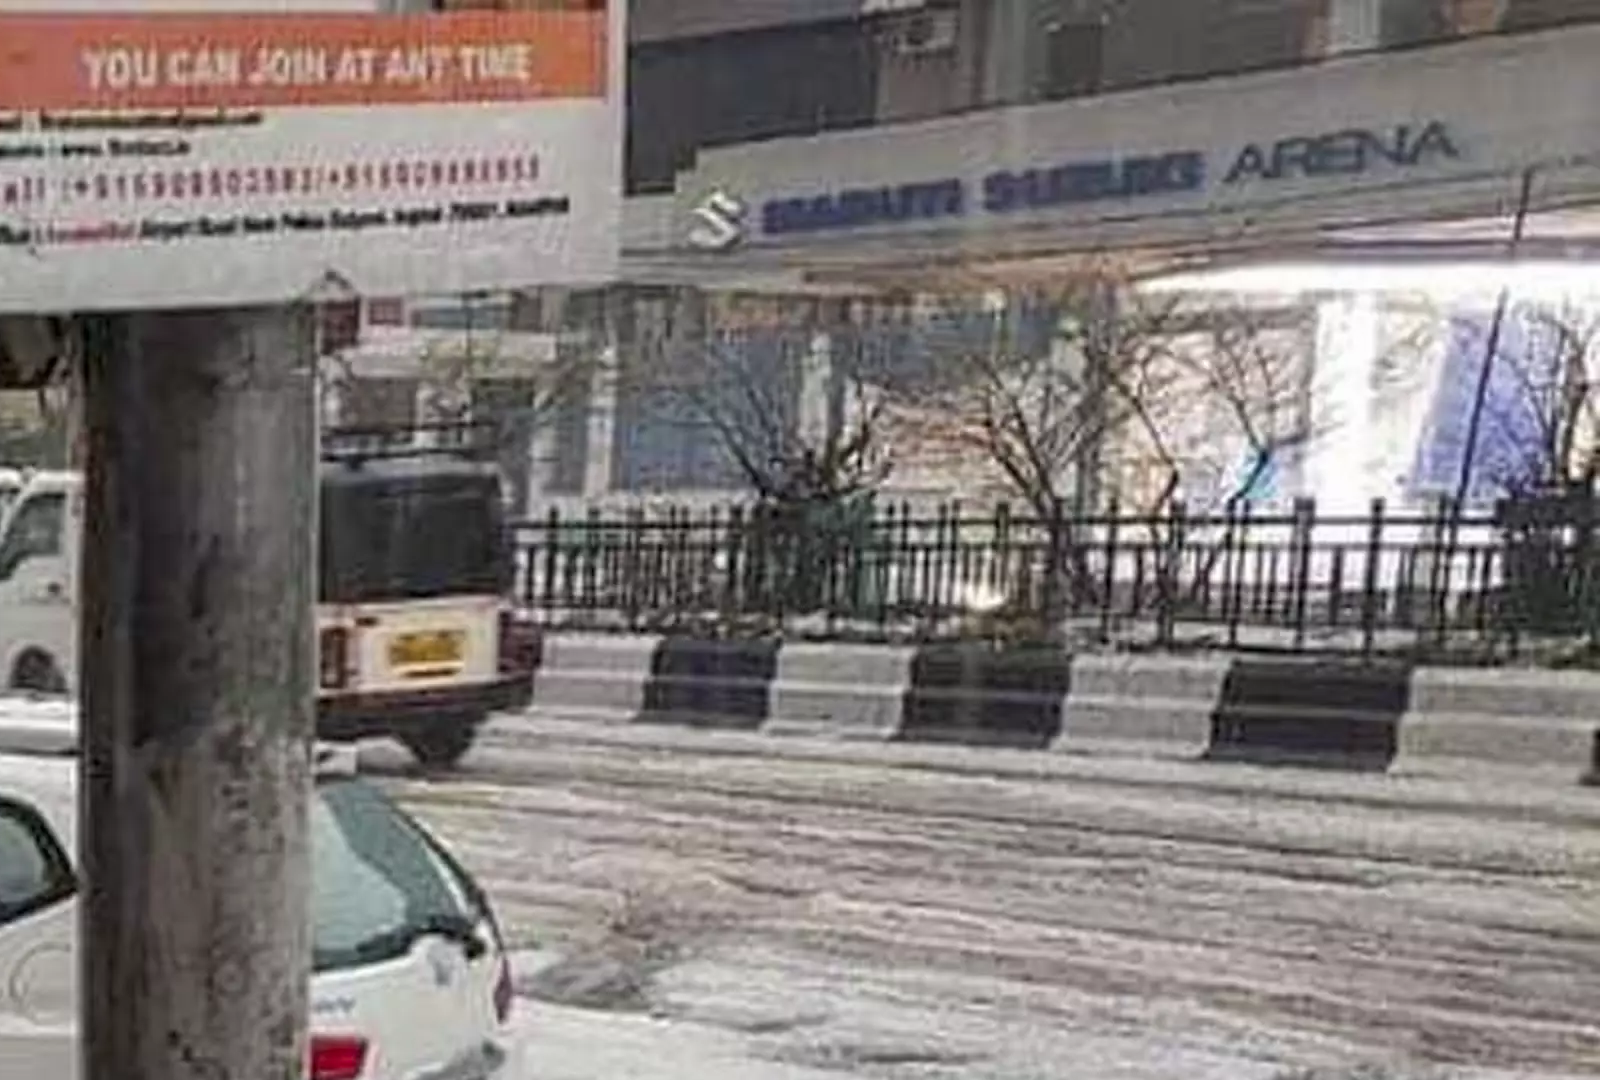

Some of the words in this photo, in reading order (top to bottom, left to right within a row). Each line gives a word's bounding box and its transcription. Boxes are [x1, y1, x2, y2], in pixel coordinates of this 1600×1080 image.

[83, 48, 157, 88] YOU
[167, 47, 238, 86] CAN
[250, 46, 326, 85] JOIN
[333, 45, 376, 83] AT
[459, 43, 532, 82] TIME
[1222, 119, 1460, 183] ARENA
